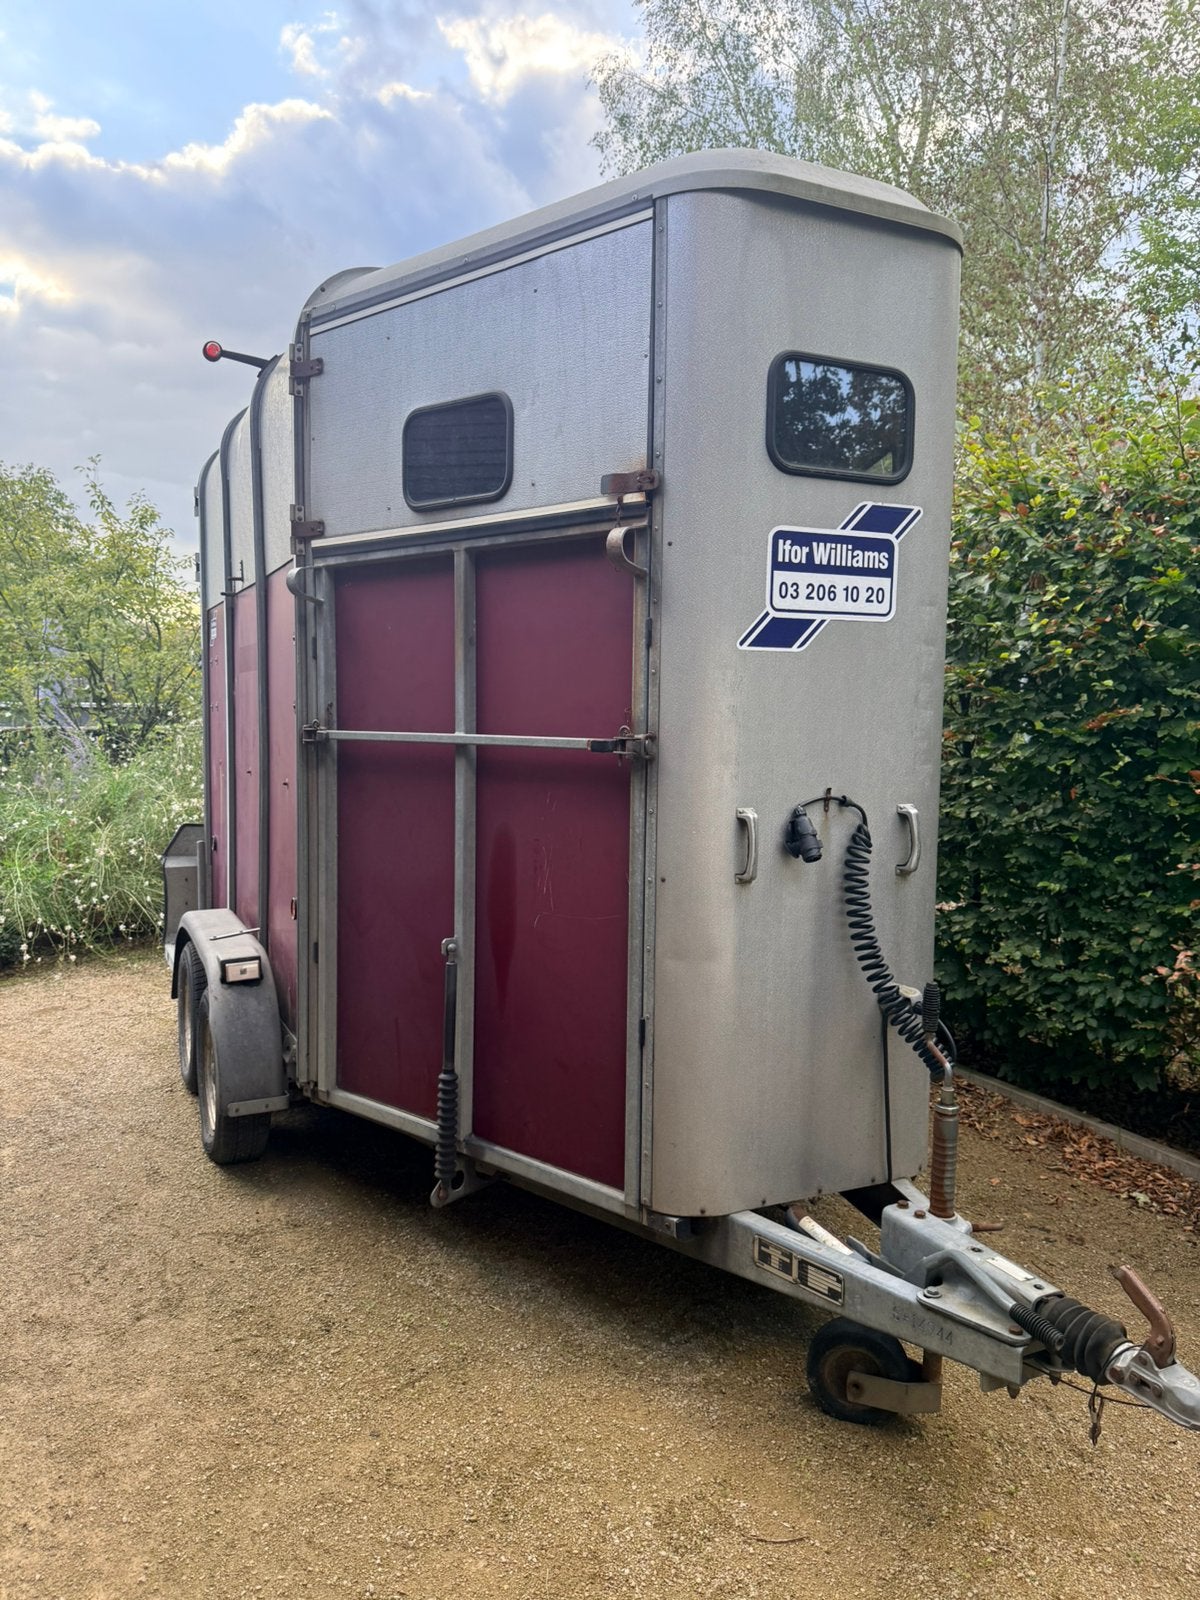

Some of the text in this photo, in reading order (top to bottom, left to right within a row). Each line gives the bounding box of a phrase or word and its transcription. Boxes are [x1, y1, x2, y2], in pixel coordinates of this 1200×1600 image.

[777, 539, 889, 570] Ifor Williams
[779, 581, 885, 605] 03 206 10 20
